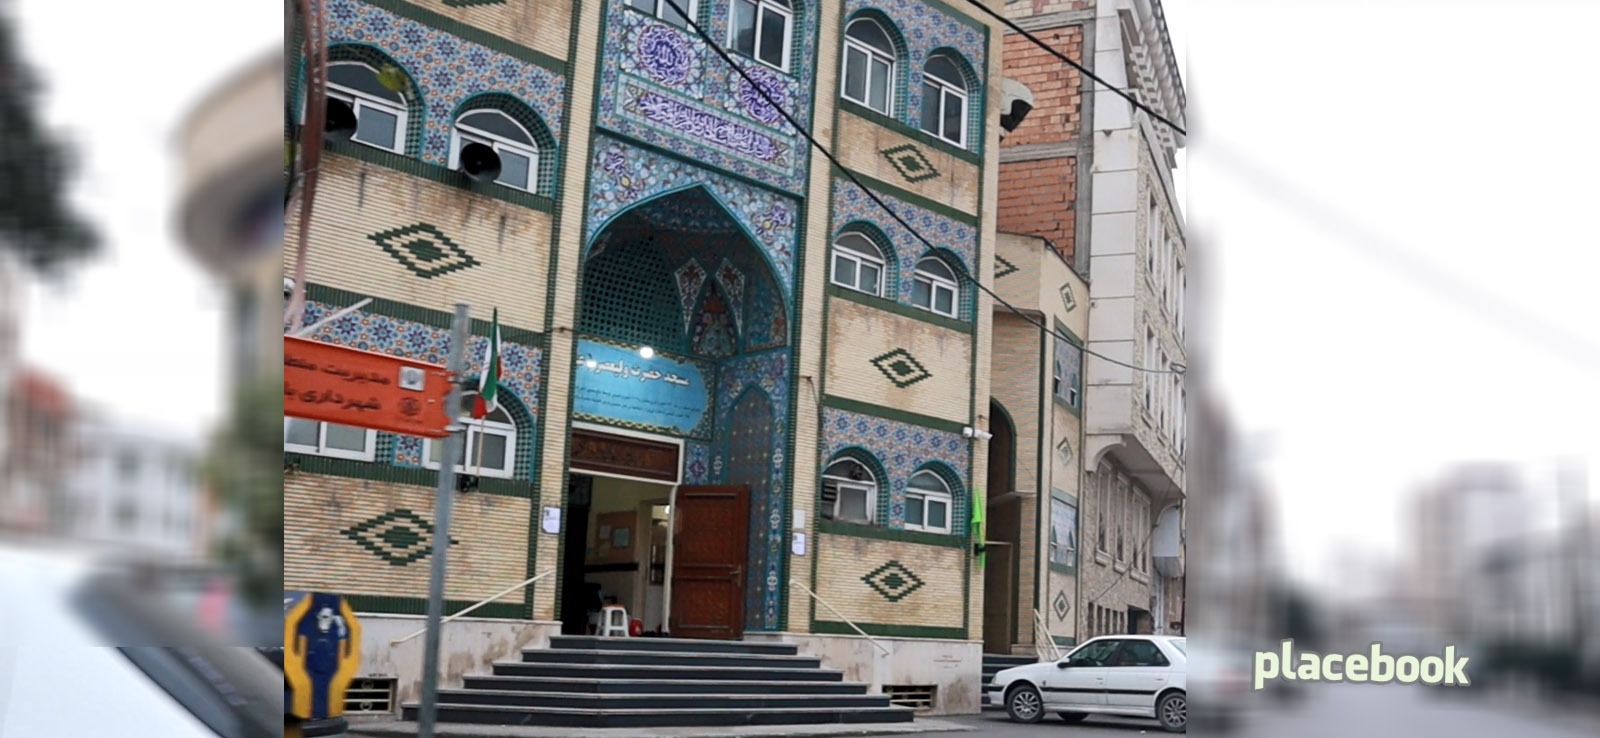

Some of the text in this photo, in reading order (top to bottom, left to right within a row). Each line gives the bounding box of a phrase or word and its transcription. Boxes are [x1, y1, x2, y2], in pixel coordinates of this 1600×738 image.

[322, 365, 391, 385] مدیریت
[630, 365, 662, 382] حضرت
[663, 372, 690, 387] مسجد
[301, 390, 382, 412] شهرداری
